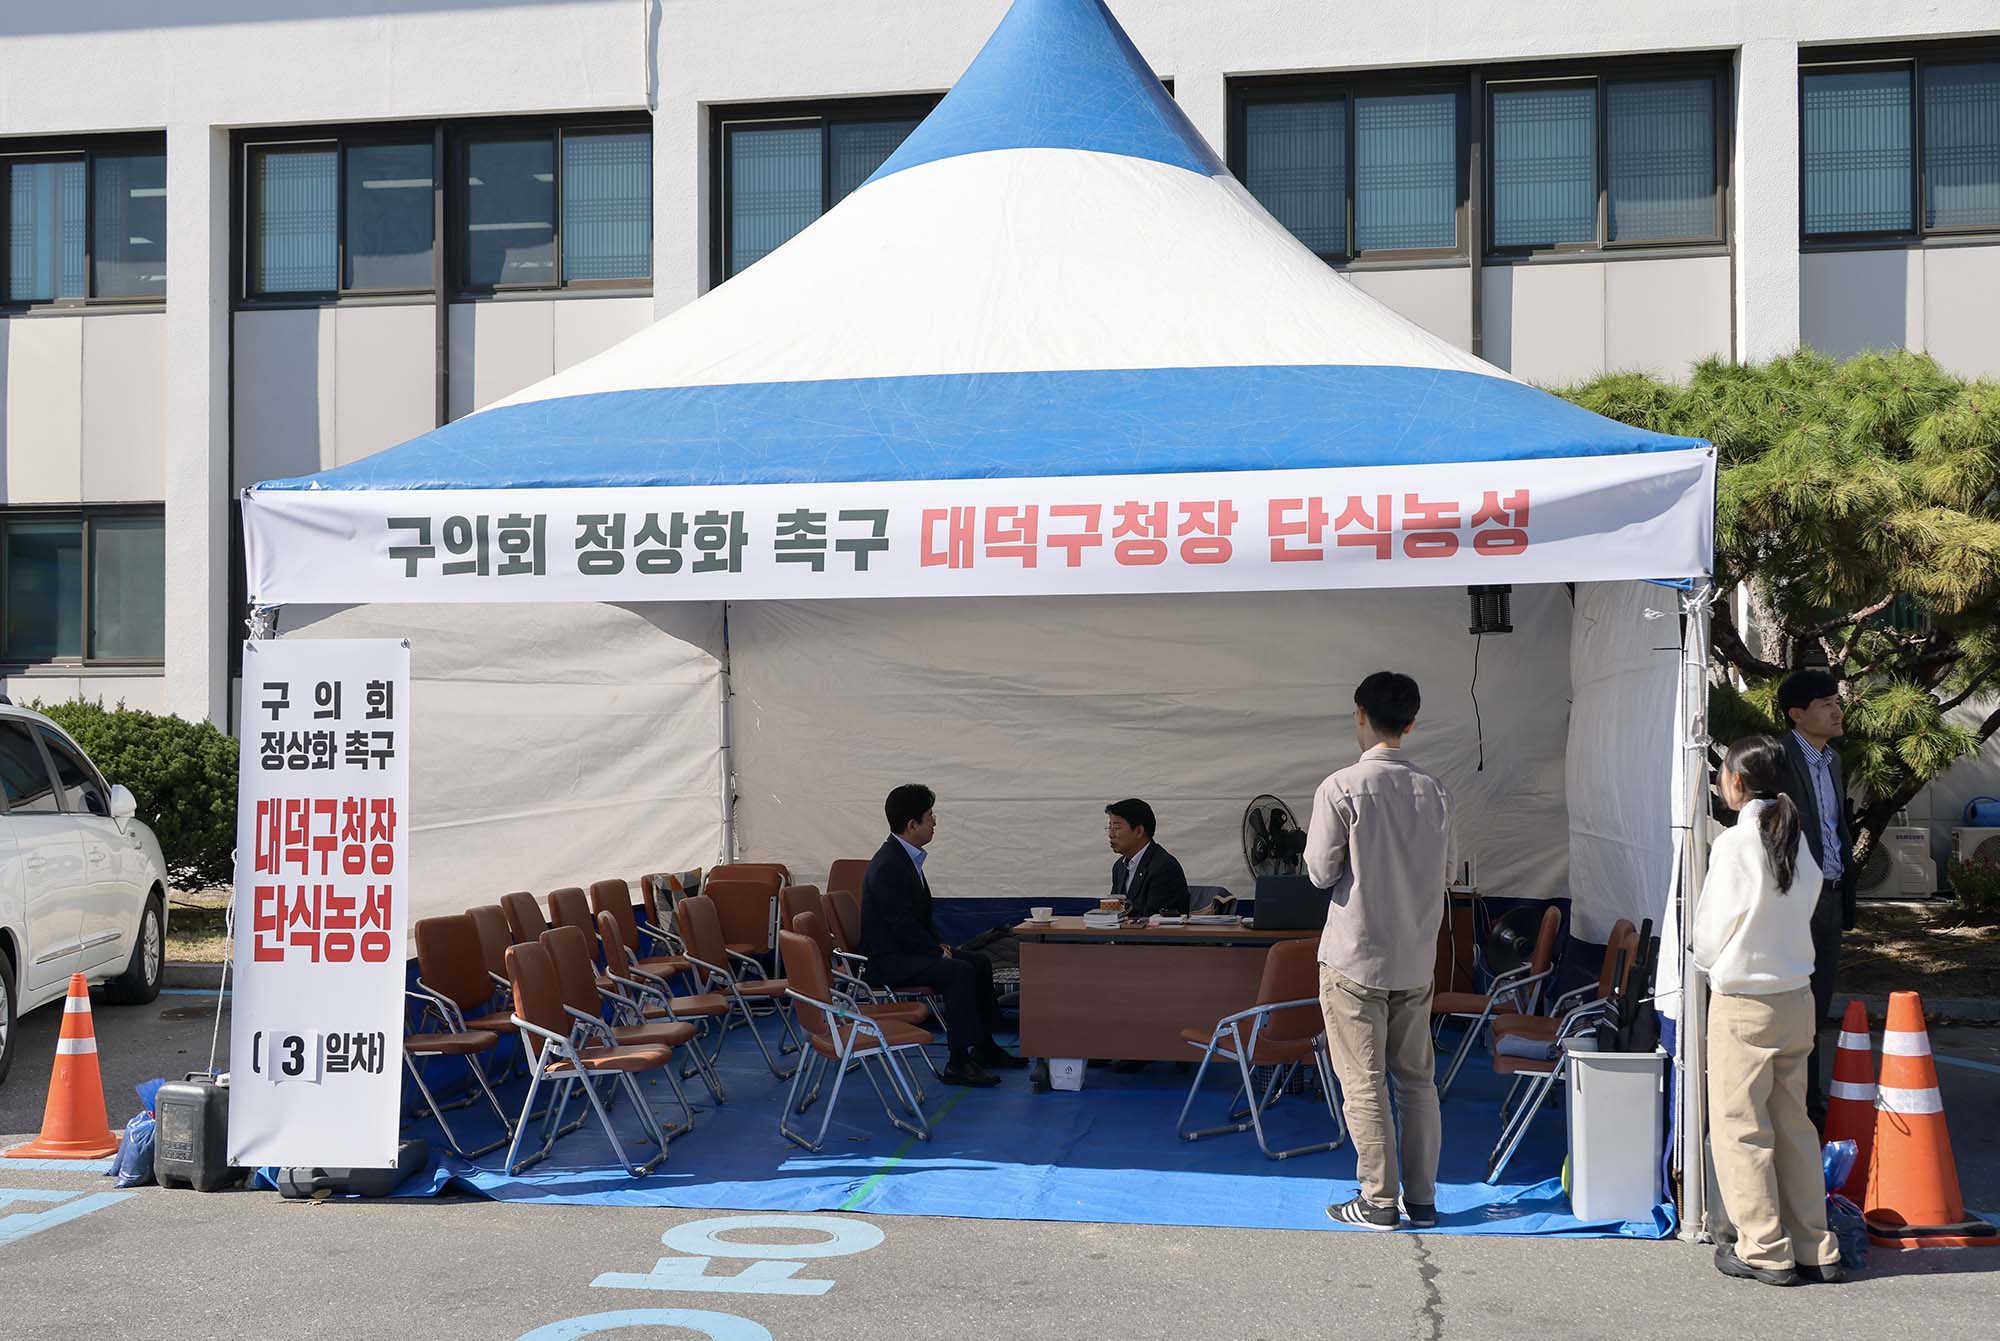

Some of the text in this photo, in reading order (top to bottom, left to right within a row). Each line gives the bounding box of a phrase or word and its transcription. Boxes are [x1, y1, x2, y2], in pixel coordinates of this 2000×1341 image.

[387, 489, 1531, 578] 구의회 정상화 촉구 대덕구청장 단식농성
[260, 730, 395, 771] 정상화 촉구
[255, 796, 397, 876] 대덕구청장
[253, 884, 392, 964] 단식농성
